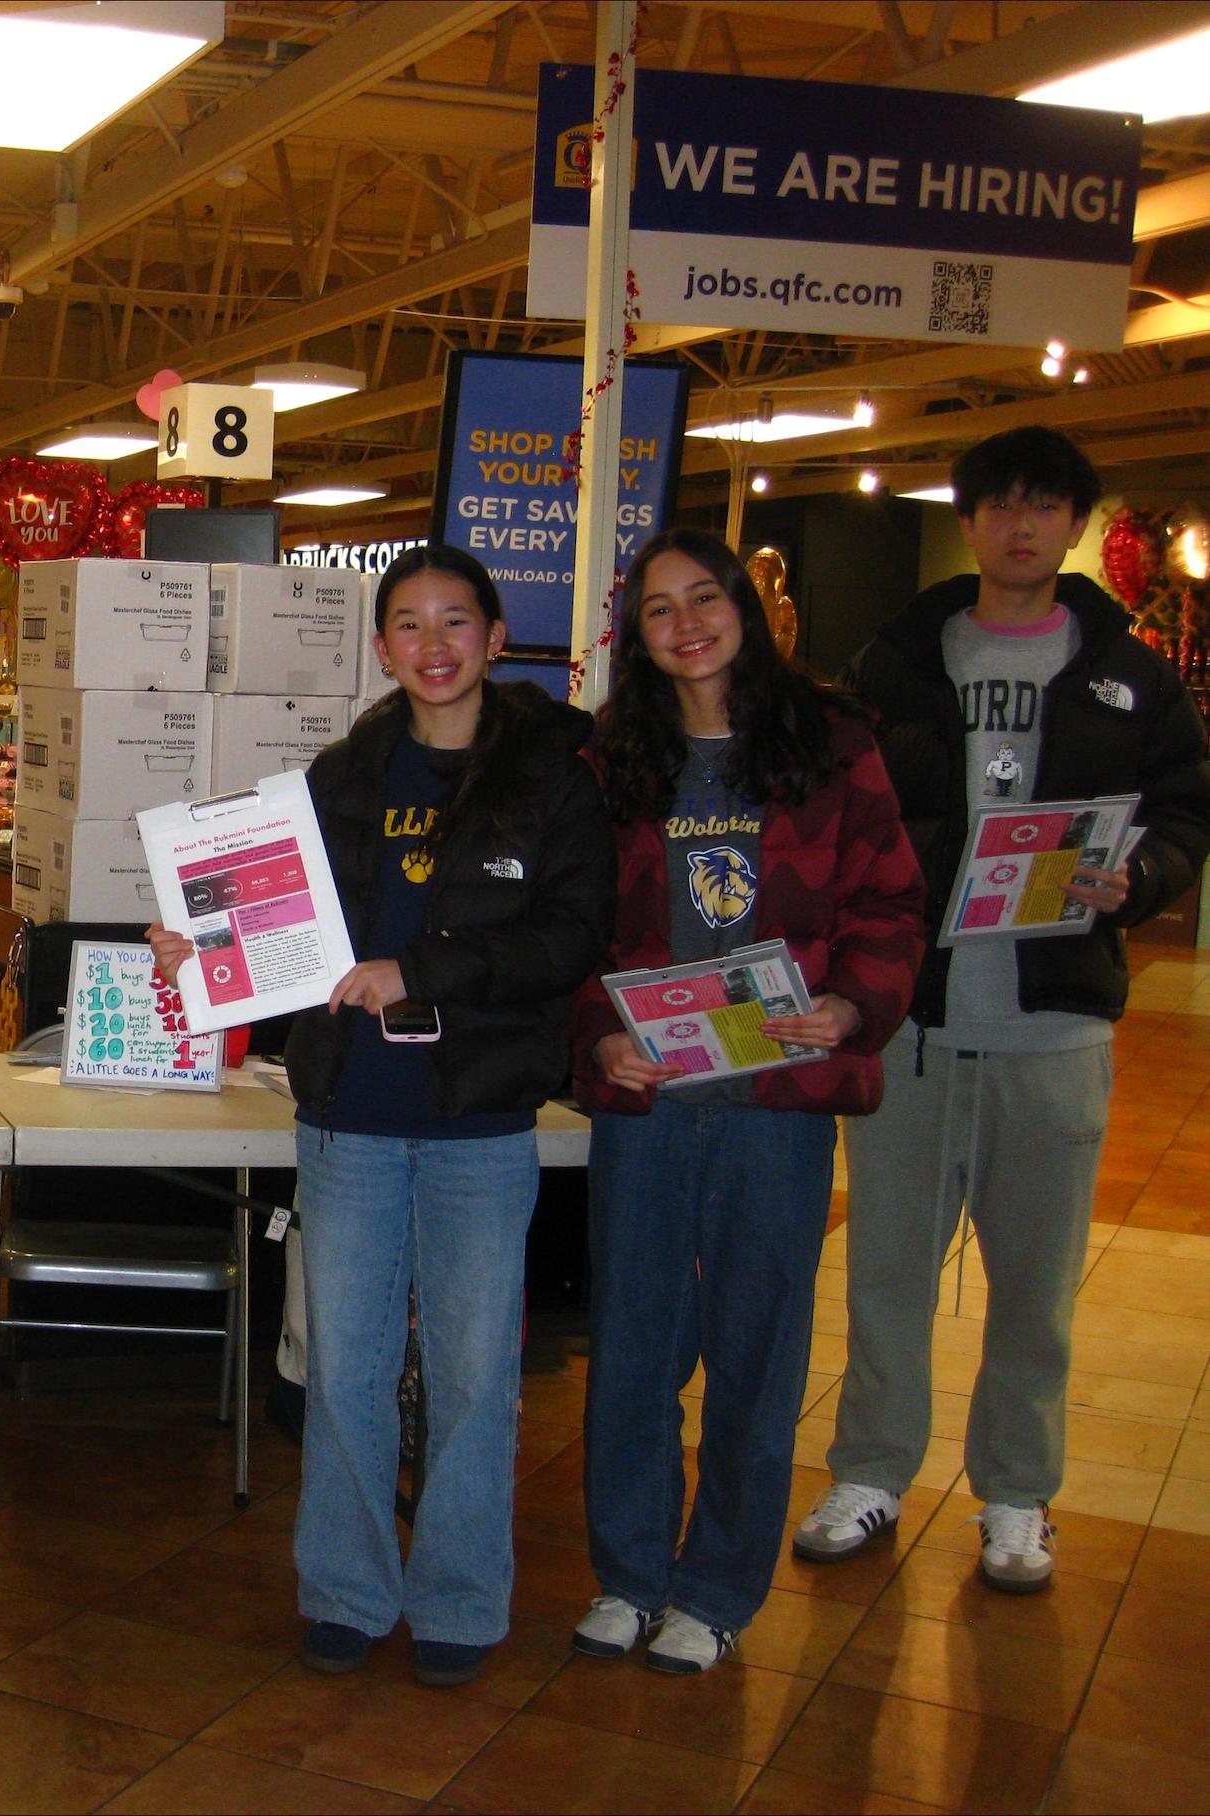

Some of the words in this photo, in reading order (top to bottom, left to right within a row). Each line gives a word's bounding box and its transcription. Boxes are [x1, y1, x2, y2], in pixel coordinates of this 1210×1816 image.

[655, 141, 758, 195] WE
[776, 151, 899, 206] ARE
[920, 161, 1124, 225] HIRING!
[685, 265, 903, 308] jobs.qfc.com
[167, 406, 179, 457] 8
[212, 405, 248, 458] 8
[469, 429, 553, 456] SHOP
[562, 433, 657, 461] FSH
[479, 461, 562, 487] YOUR
[8, 497, 74, 526] LOVE
[457, 495, 519, 520] GET
[527, 499, 653, 526] SAVGS
[469, 526, 568, 552] EVERY
[487, 568, 557, 583] WNLOAD
[160, 582, 193, 591] P509761
[160, 591, 165, 599] 6
[167, 591, 193, 600] Pieces
[315, 597, 320, 605] 6
[322, 597, 345, 605] Pieces
[163, 722, 169, 730] 6
[170, 722, 196, 730] Pieces
[164, 713, 196, 722] P509761
[301, 717, 331, 725] P509761
[1000, 761, 1012, 771] P
[173, 843, 197, 854] About
[198, 838, 212, 847] The
[214, 831, 246, 843] Rukmini
[247, 818, 291, 834] Foundation
[213, 845, 226, 853] The
[227, 839, 254, 850] Mission
[483, 862, 509, 871] NORTH
[490, 870, 510, 878] FACE
[87, 950, 112, 962] HOW
[117, 951, 138, 963] YOU
[140, 951, 155, 963] CA
[86, 962, 113, 984] $1
[120, 968, 144, 986] buys
[77, 986, 124, 1010] $10
[128, 994, 152, 1008] buys
[77, 1012, 125, 1036] $20
[128, 1013, 151, 1026] buys
[127, 1021, 152, 1030] lunch
[132, 1028, 149, 1037] for
[76, 1037, 125, 1062] $60
[145, 1040, 178, 1050] support
[130, 1055, 153, 1063] lunch
[156, 1056, 169, 1065] for
[173, 1040, 196, 1069] 1
[76, 1062, 85, 1074] A
[87, 1064, 119, 1075] LITTLE
[123, 1065, 148, 1076] GOES
[151, 1068, 158, 1078] A
[162, 1069, 188, 1079] LONG
